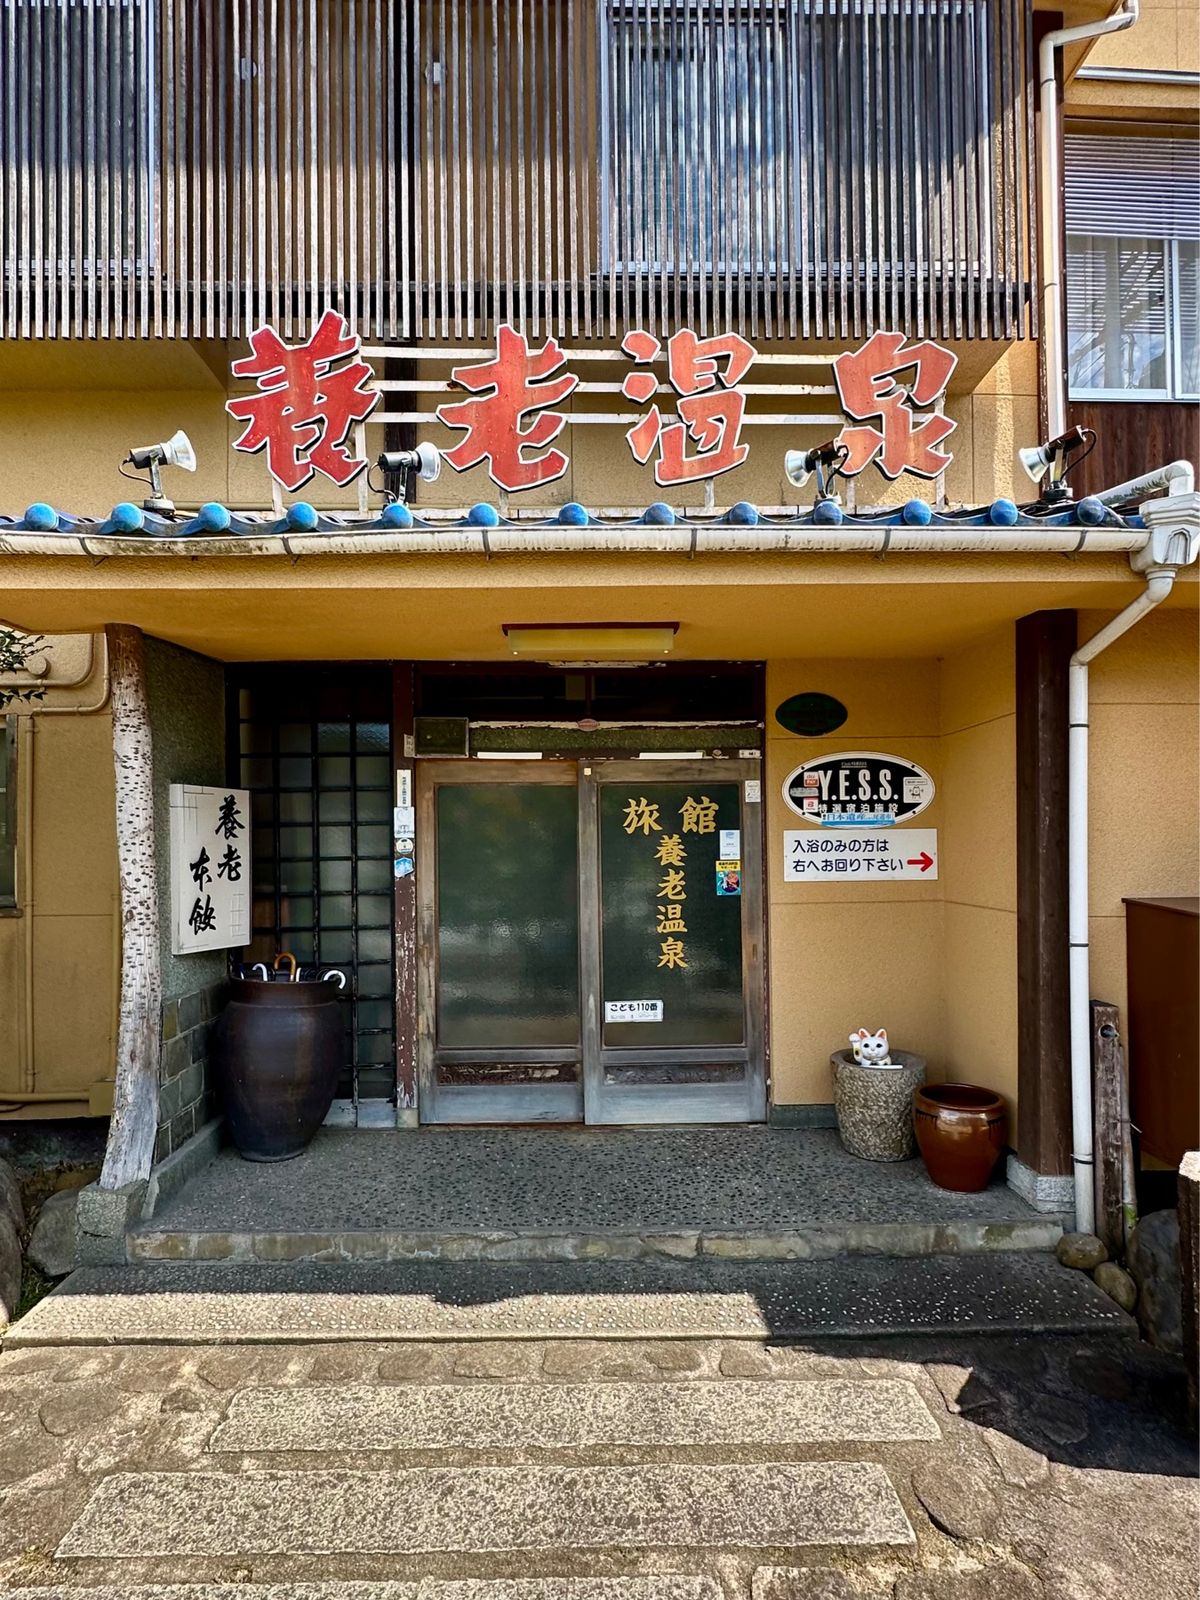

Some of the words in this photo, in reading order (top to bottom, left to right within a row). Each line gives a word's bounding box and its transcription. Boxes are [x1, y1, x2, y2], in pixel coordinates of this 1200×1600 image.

[225, 308, 959, 492] 養老温泉
[818, 768, 899, 801] Y.E.S.S.
[622, 796, 719, 835] 旅館
[818, 803, 899, 814] 特選宿泊施設
[215, 794, 245, 881] 養老
[792, 839, 889, 853] 入浴のみの方は
[792, 858, 904, 873] 右へお回り下さい
[654, 833, 688, 969] 養老温泉
[610, 1002, 658, 1012] こども110番
